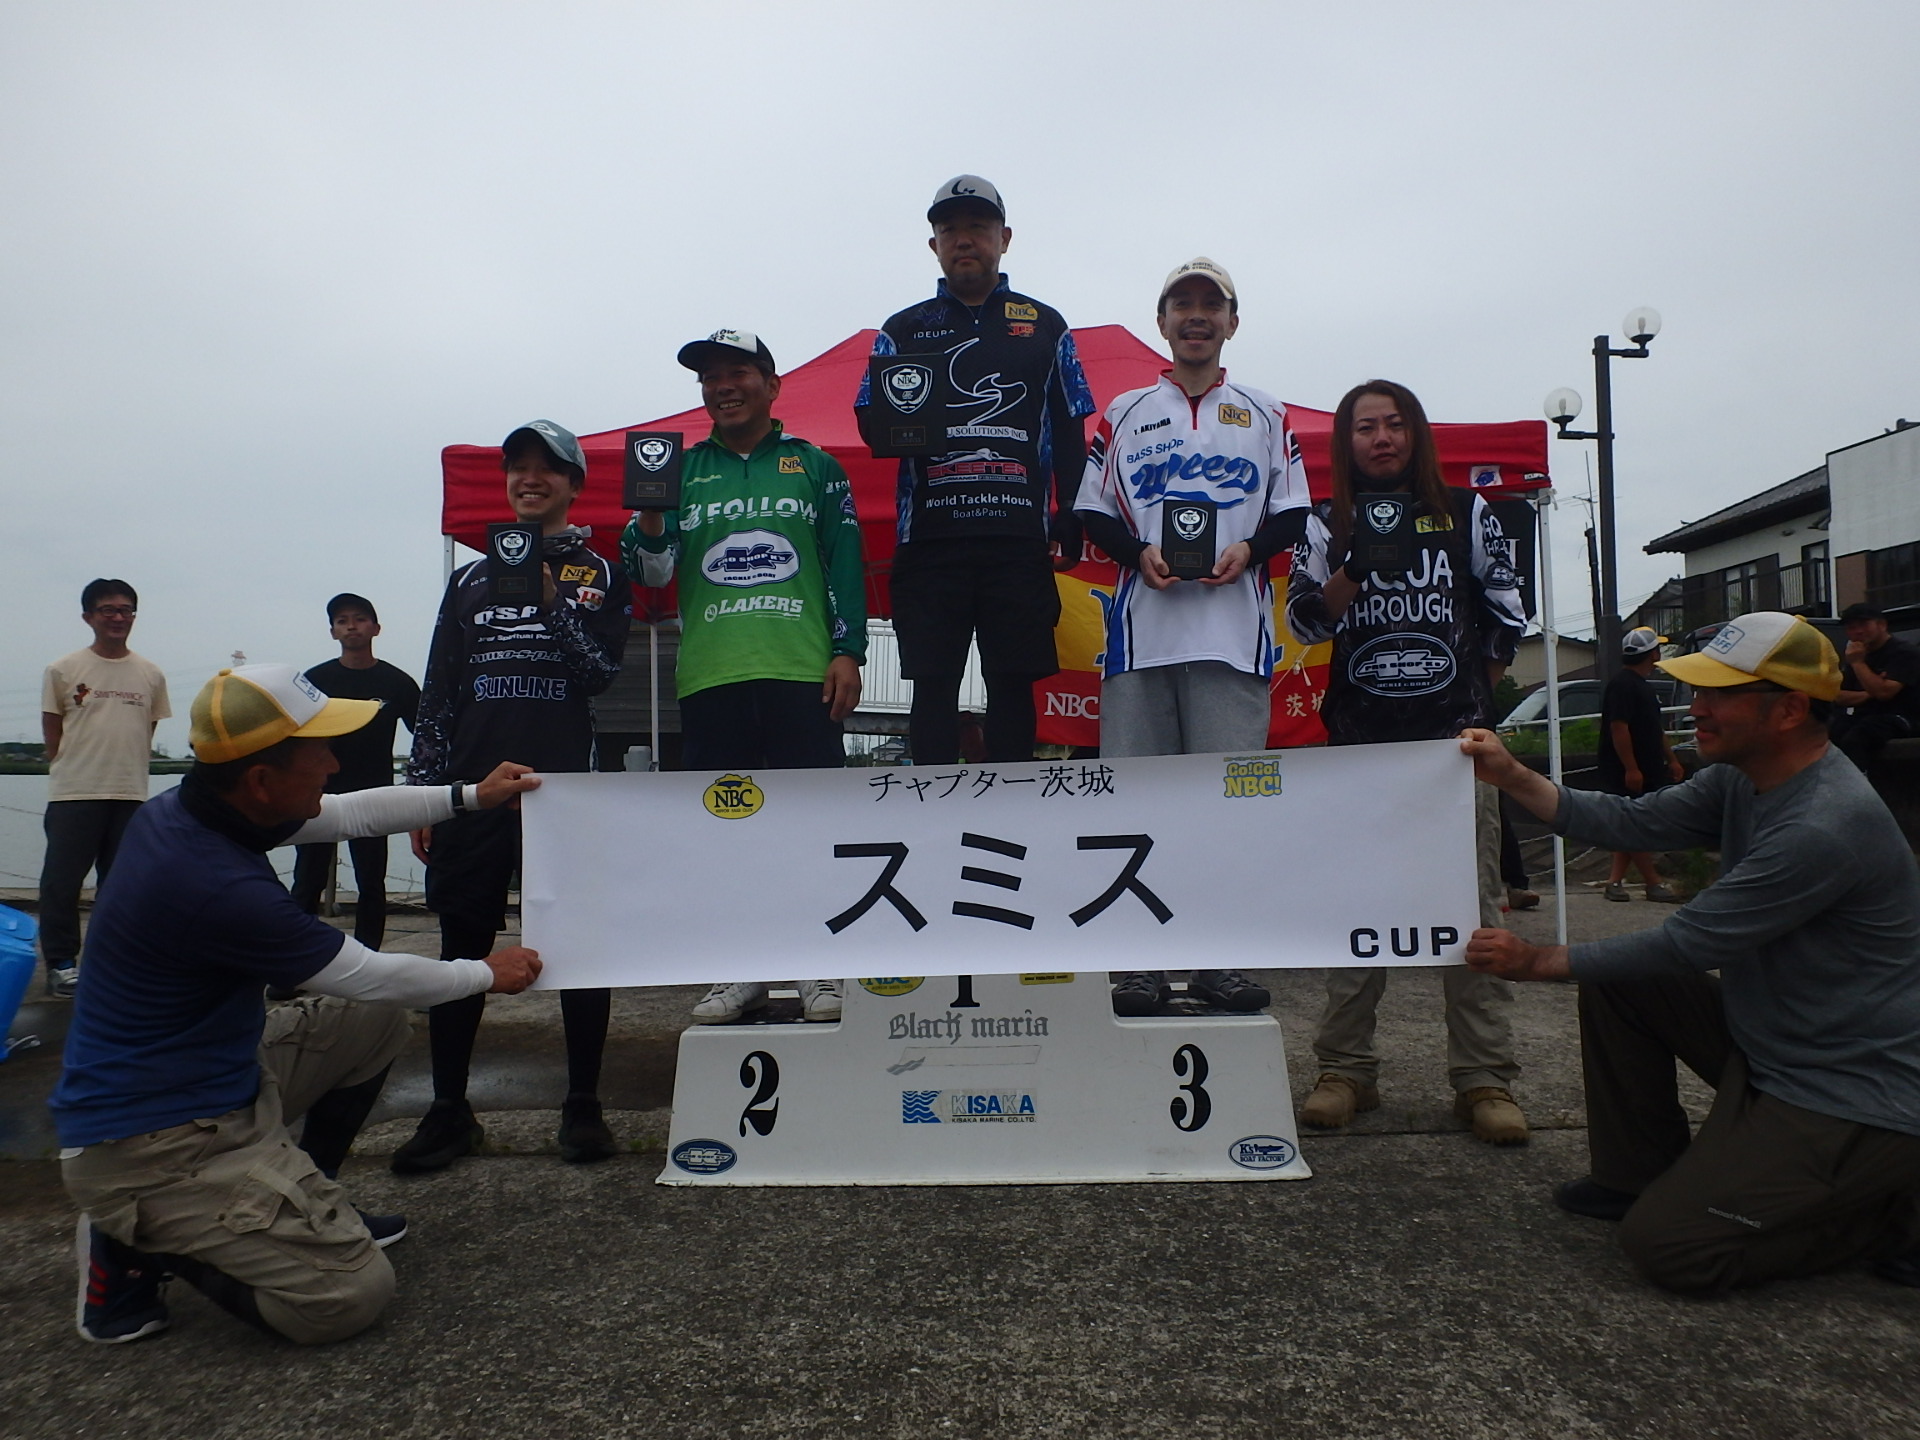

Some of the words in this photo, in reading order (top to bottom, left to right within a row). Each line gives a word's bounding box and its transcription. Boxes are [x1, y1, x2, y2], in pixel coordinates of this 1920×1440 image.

[1222, 409, 1248, 423] NBC
[955, 425, 1010, 436] SOLUTIONS
[1126, 445, 1153, 464] BASS
[1155, 438, 1184, 454] SHOP
[927, 461, 1028, 479] SKEETER
[707, 496, 818, 525] FOLLOW
[926, 494, 957, 509] World
[960, 493, 999, 505] Tackle
[953, 508, 1007, 519] Boat&Parts
[718, 595, 804, 615] LAKER'S
[474, 674, 567, 702] SUNLINE
[1044, 692, 1100, 720] NBC
[1227, 761, 1279, 777] Go!Go!
[868, 764, 1115, 802] チャプター茨城
[1223, 774, 1282, 798] NBC!
[713, 788, 754, 808] NBC
[825, 832, 1175, 935] スミス
[1350, 926, 1459, 958] CUP
[888, 1010, 963, 1045] Black
[739, 1050, 779, 1137] 2
[1170, 1043, 1211, 1132] 3
[951, 1094, 1035, 1114] KISAKA
